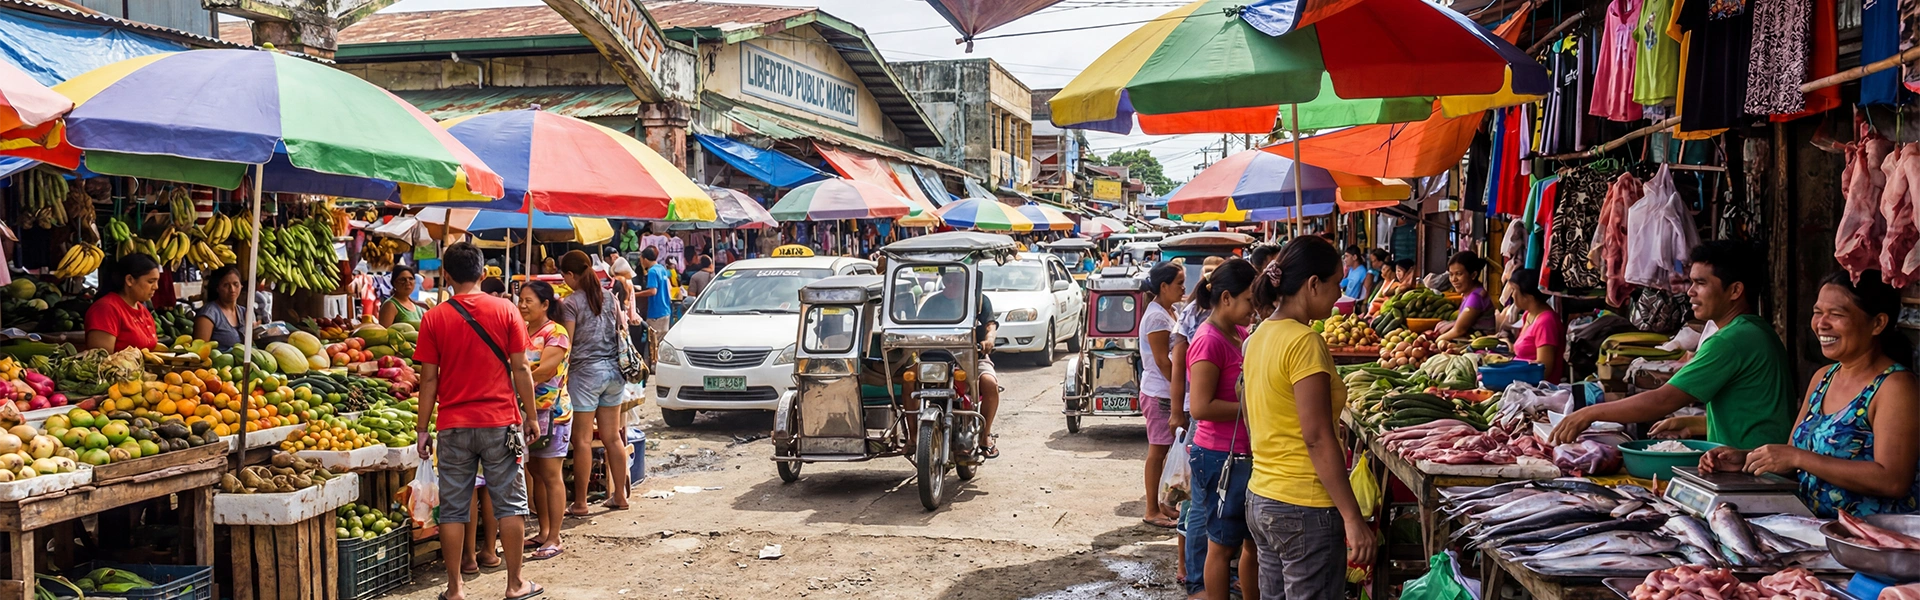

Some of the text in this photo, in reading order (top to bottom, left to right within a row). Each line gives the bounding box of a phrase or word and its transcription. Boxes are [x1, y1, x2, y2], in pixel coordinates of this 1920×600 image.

[747, 50, 855, 117] LIBERTAD PUBLIC MARKET
